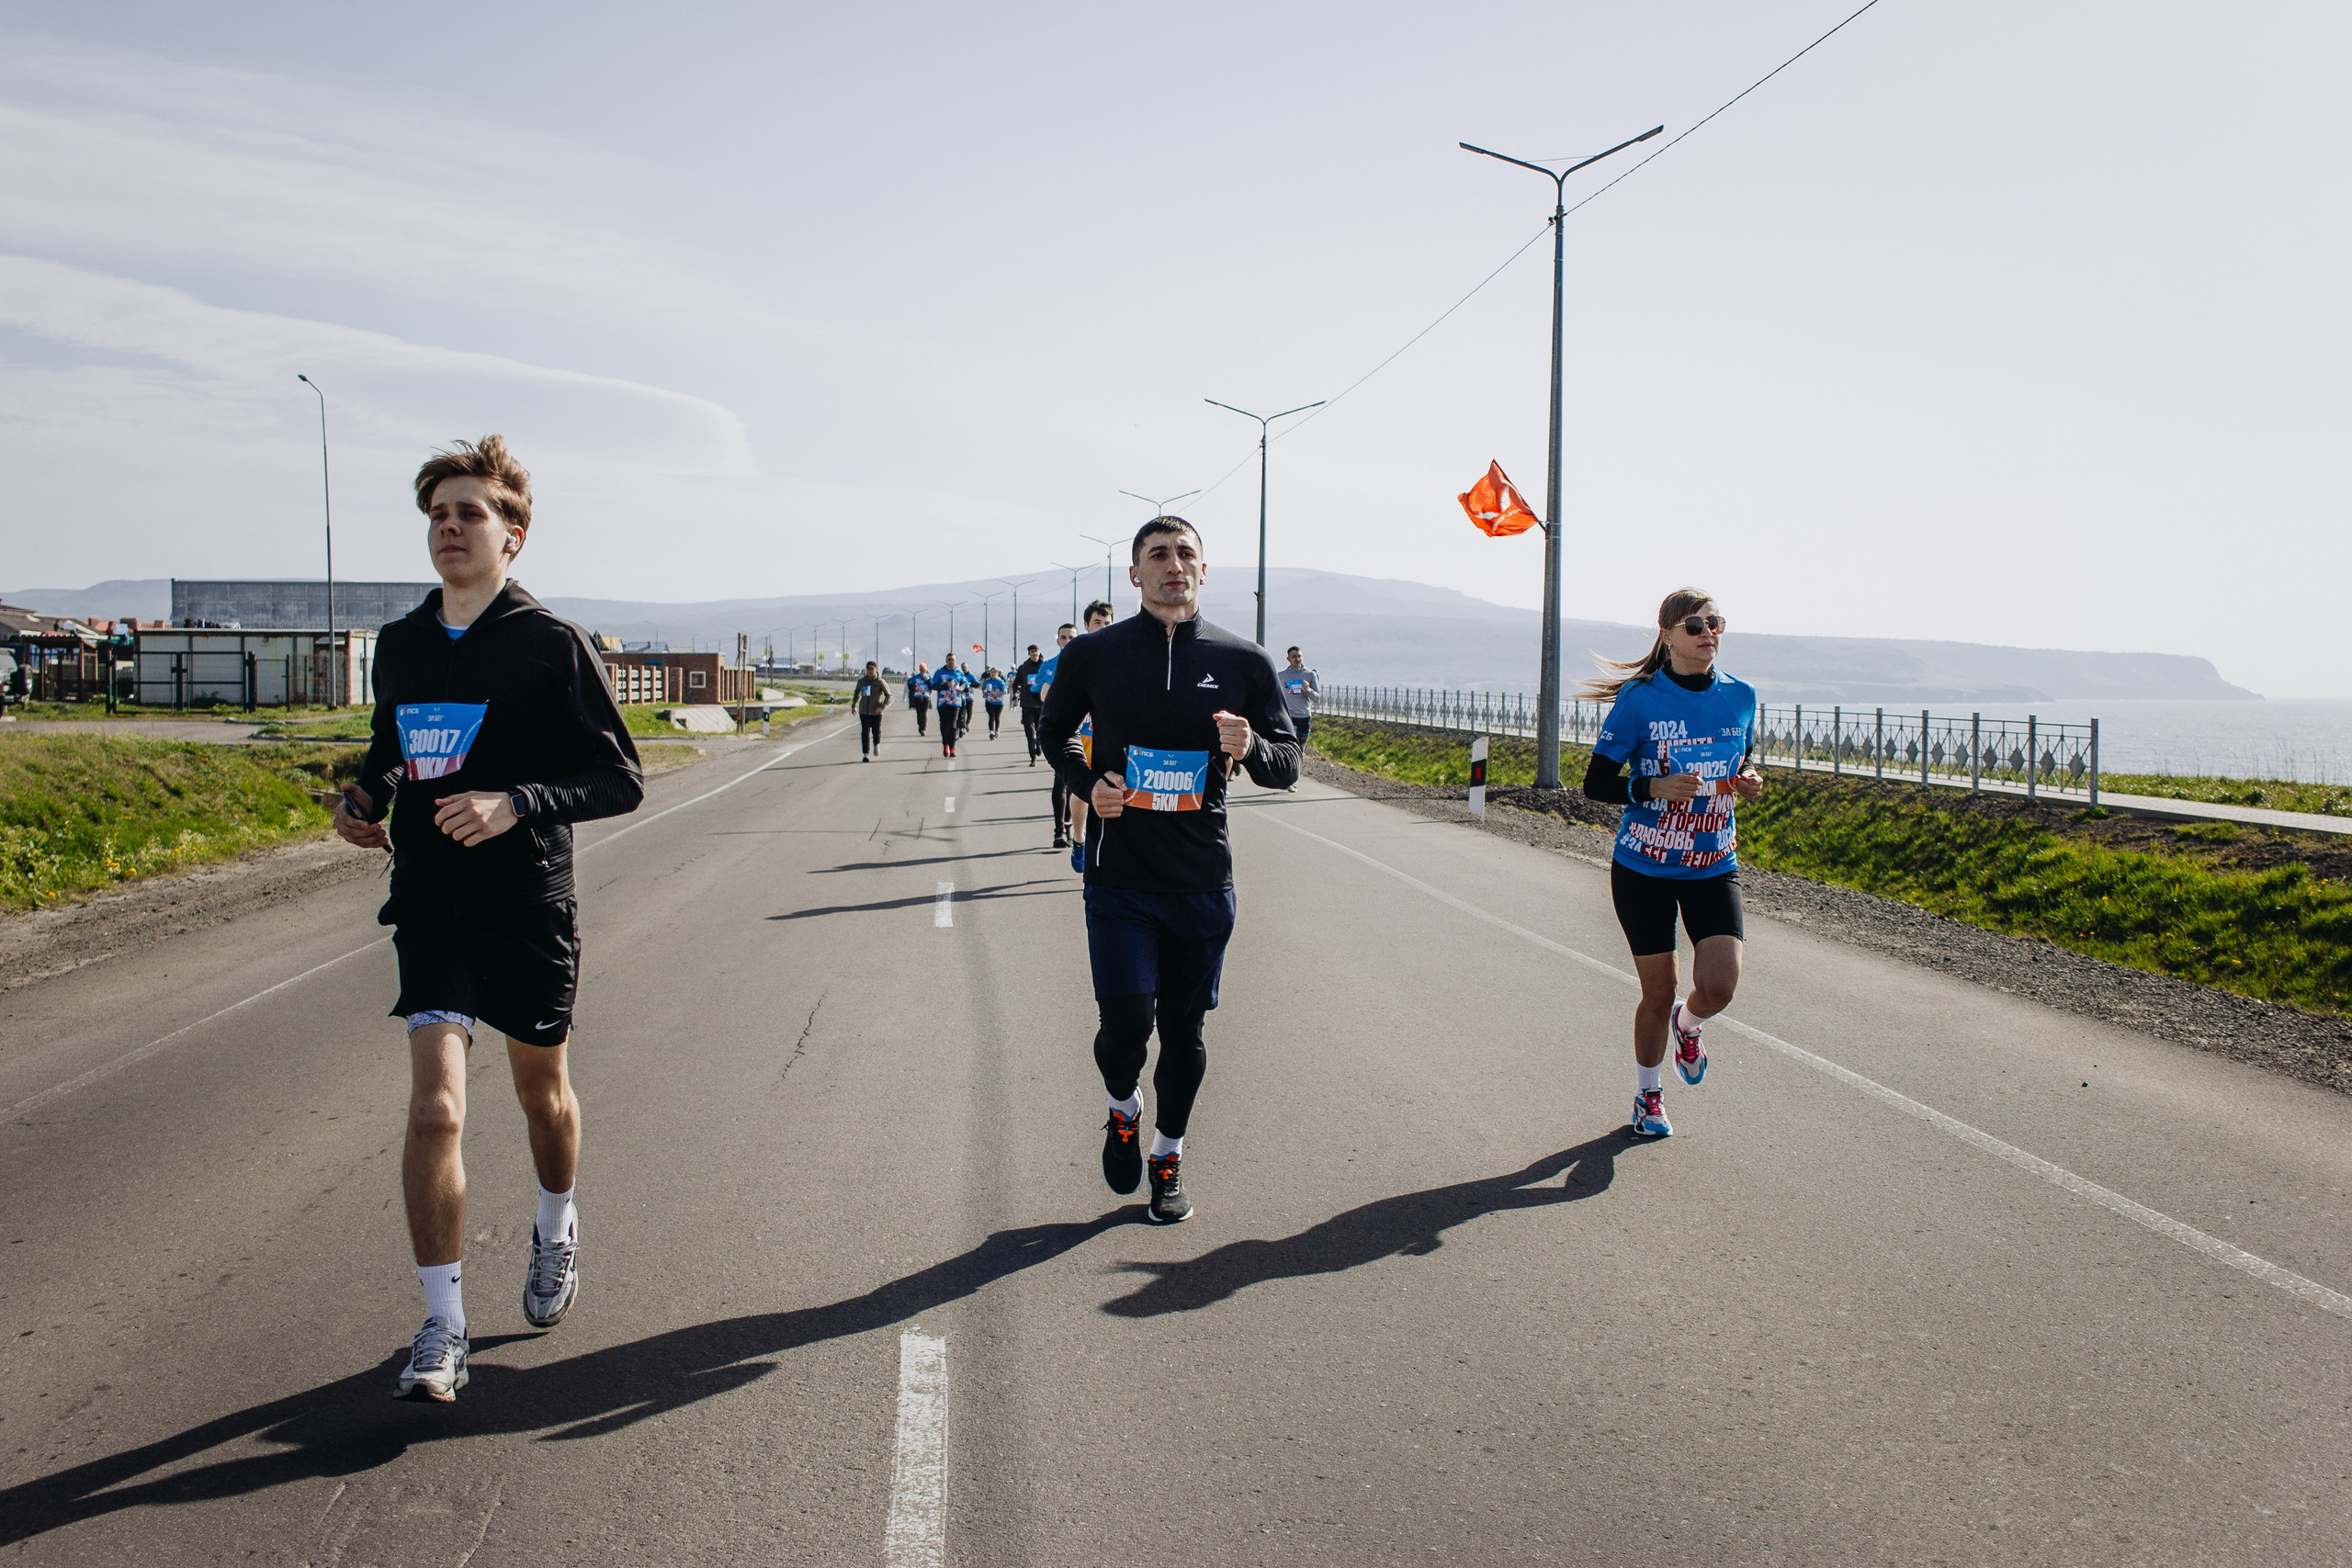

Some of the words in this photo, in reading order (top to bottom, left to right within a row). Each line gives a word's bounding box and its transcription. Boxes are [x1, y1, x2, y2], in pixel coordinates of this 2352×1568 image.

[1600, 730, 1614, 741] СБ
[1648, 719, 1689, 740] 2024
[409, 728, 461, 754] 30017
[1640, 758, 1670, 776] #ЗАБ
[1143, 769, 1194, 791] 20006
[1628, 821, 1695, 851] #ЛЮБОВЬ
